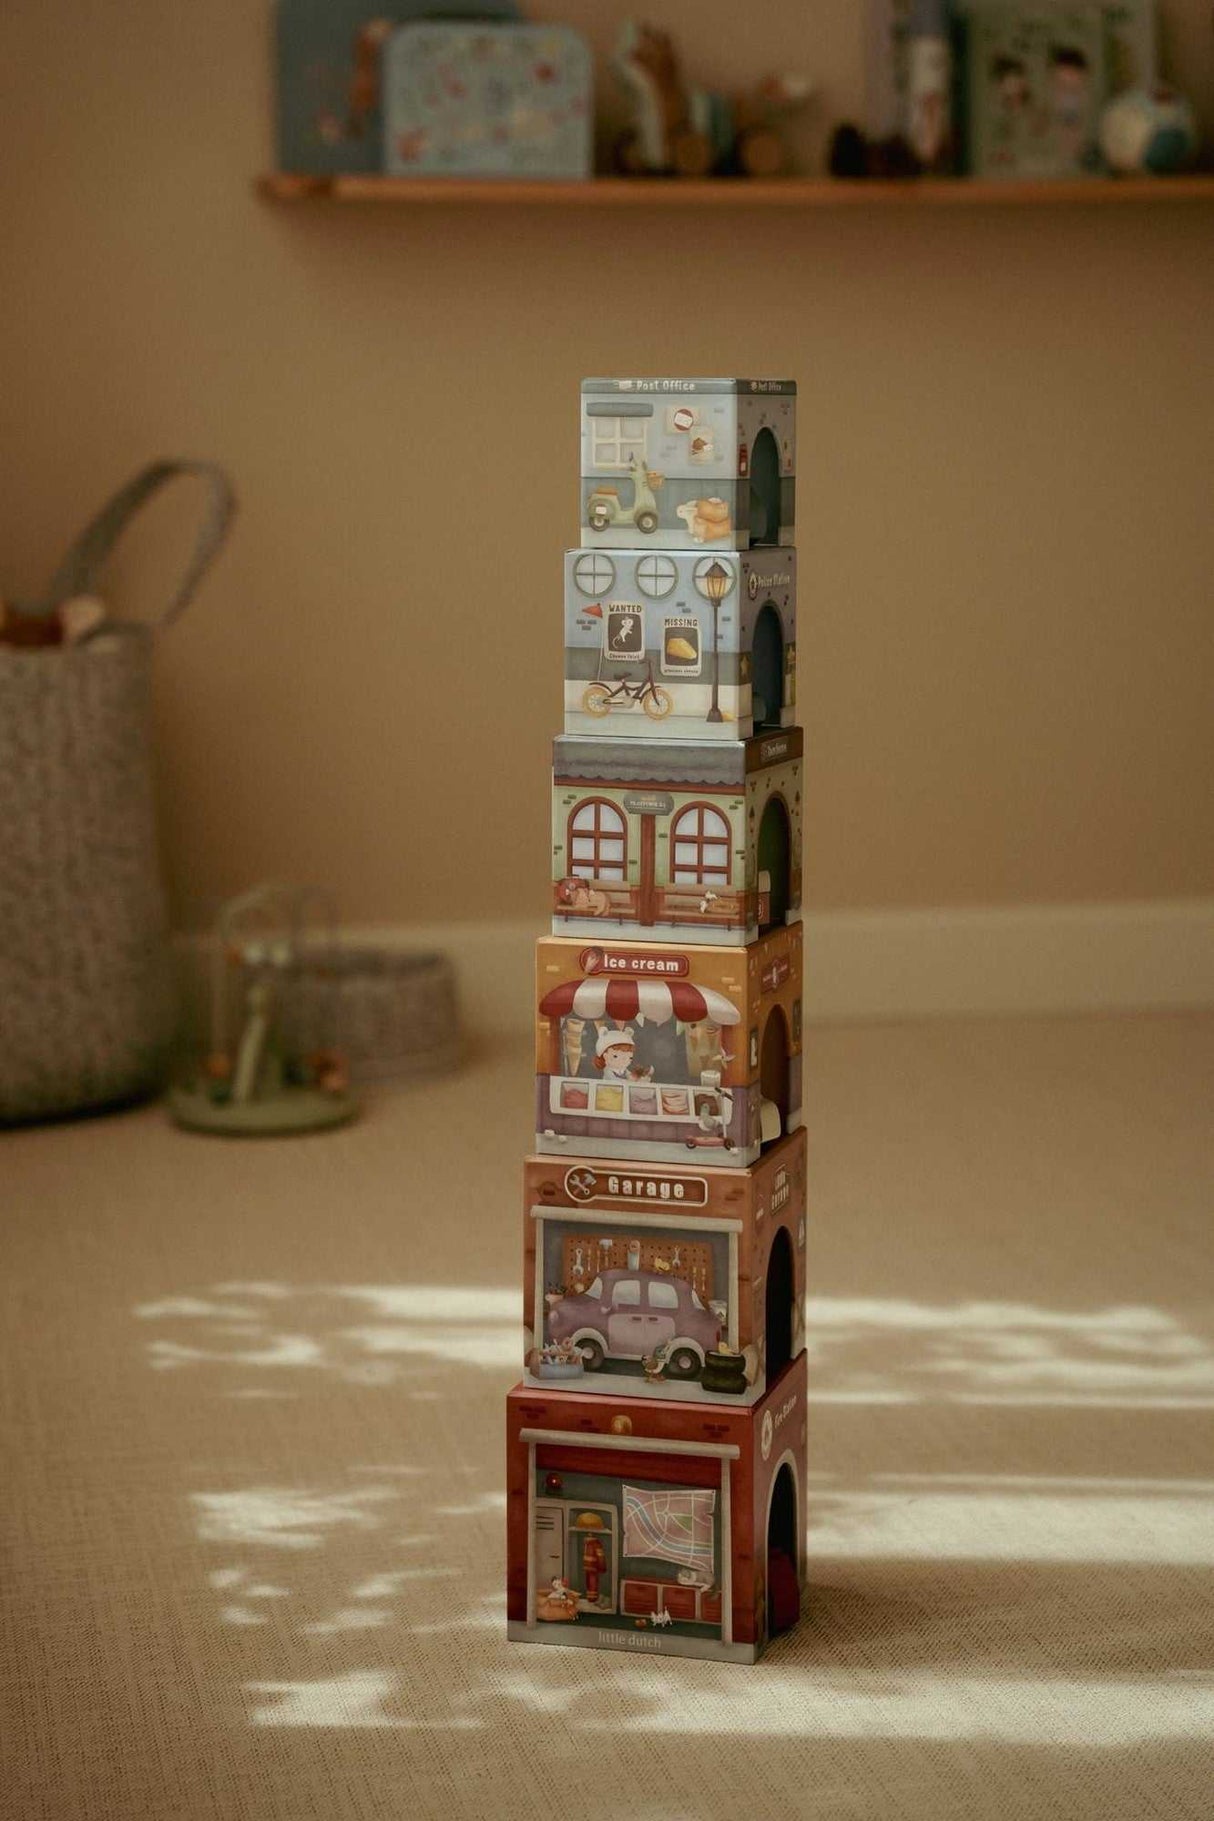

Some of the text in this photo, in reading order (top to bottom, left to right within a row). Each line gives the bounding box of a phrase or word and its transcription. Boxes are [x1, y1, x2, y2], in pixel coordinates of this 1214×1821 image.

[637, 380, 696, 391] Post Office
[608, 604, 642, 613] WANTED
[664, 618, 698, 627] MISSING
[631, 959, 679, 971] cream
[608, 1176, 684, 1199] Garage
[598, 1631, 662, 1649] little dutch
